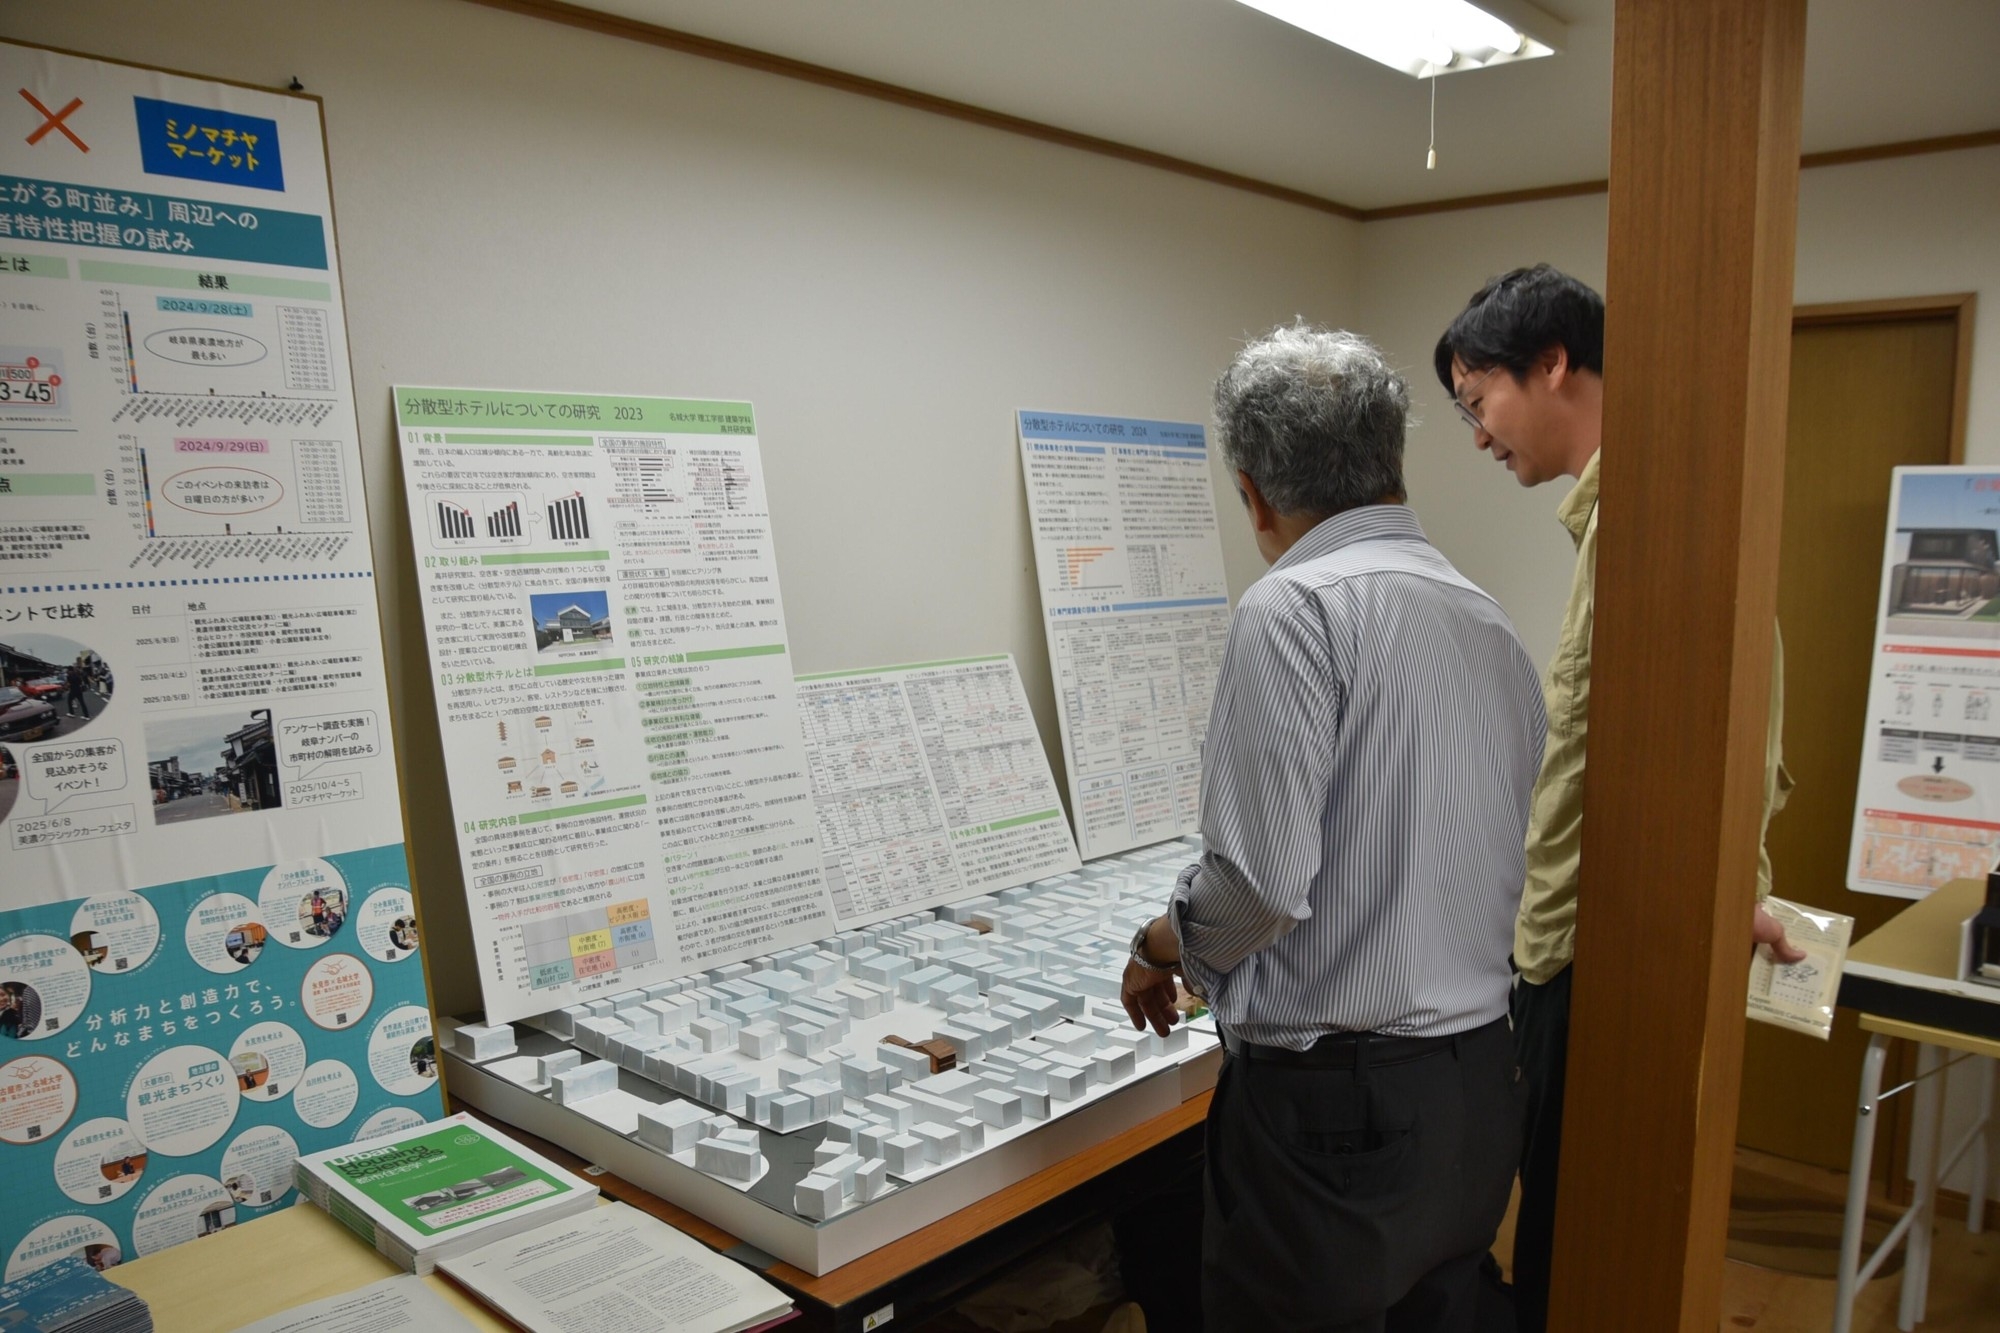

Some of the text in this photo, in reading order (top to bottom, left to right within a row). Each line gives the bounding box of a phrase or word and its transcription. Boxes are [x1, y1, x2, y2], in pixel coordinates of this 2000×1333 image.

[166, 119, 259, 150] ミノマチヤ
[167, 142, 259, 171] マーケット
[199, 275, 229, 290] 結果
[191, 351, 226, 361] 最も多い
[11, 369, 32, 379] 500
[405, 398, 643, 421] 分散型ホテルについての研究 2023
[1024, 419, 1147, 437] 分散型ホテルについての研究 2024
[423, 433, 443, 443] 背景
[176, 480, 269, 490] このイベントの来訪者は
[424, 556, 478, 568] 02 取り組み
[0, 603, 95, 622] ントで比較
[132, 605, 150, 614] 日付
[188, 602, 206, 611] 地点
[631, 654, 685, 668] 05 研究の結論
[441, 668, 534, 685] 03 分散型ホテルとは
[284, 717, 370, 734] アンケート調査も実施！
[301, 732, 359, 747] 岐阜ナンバーの
[32, 745, 117, 763] 全国からの集客が
[289, 744, 373, 762] 市町村の解明を試みる
[45, 762, 108, 778] 見込めそうな
[54, 778, 100, 791] イベント！
[290, 789, 359, 805] ミノマチヤマーケット
[17, 817, 71, 832] 2025/6/8
[464, 816, 518, 833] 04 研究内容
[18, 822, 131, 845] 美濃クラシックカーフェスタ
[480, 869, 538, 886] 全国の事例の立地
[86, 979, 273, 1031] 分析力と創造力で、
[66, 995, 296, 1058] どんなまちをつくろう。
[138, 1074, 225, 1106] 観光まちづくり
[331, 1146, 397, 1166] Urban
[341, 1144, 428, 1172] Housing
[349, 1149, 444, 1179] Sciences
